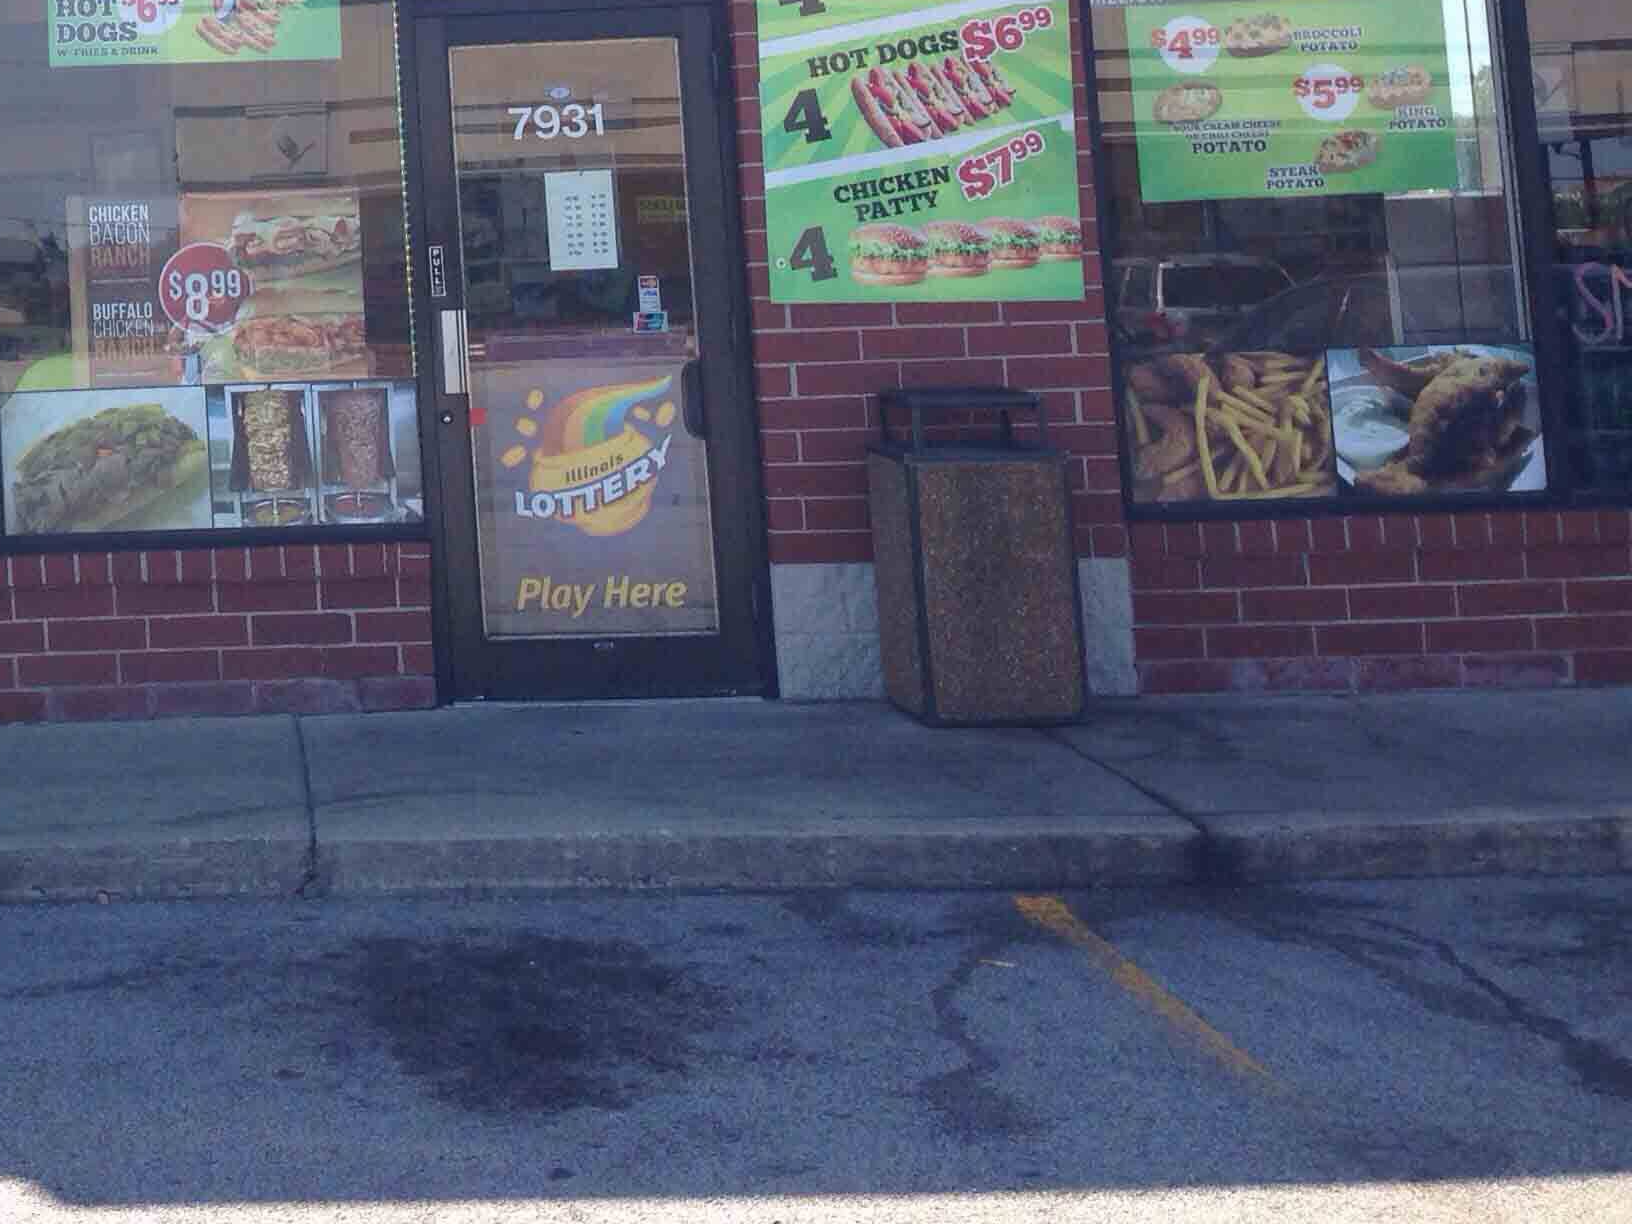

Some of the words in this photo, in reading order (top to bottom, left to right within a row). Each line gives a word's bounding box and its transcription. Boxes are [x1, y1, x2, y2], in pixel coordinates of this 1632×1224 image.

[56, 22, 138, 44] DOGS
[808, 47, 869, 78] HOT
[878, 29, 960, 65] DOGS
[507, 103, 606, 141] 7931
[783, 88, 833, 144] 4
[1388, 118, 1448, 130] POTATO
[1191, 139, 1267, 154] POTATO
[833, 165, 952, 204] CHICKEN
[1266, 176, 1325, 190] POTATO
[88, 204, 150, 224] CHICKEN
[854, 190, 939, 223] PATTY
[89, 222, 151, 244] BACON
[90, 246, 151, 268] RANCH
[788, 226, 838, 282] 4
[92, 302, 153, 320] BUFFALO
[93, 319, 155, 338] CHICKEN
[514, 434, 673, 519] LOTTERY
[517, 575, 597, 618] Play
[603, 575, 688, 609] Here
